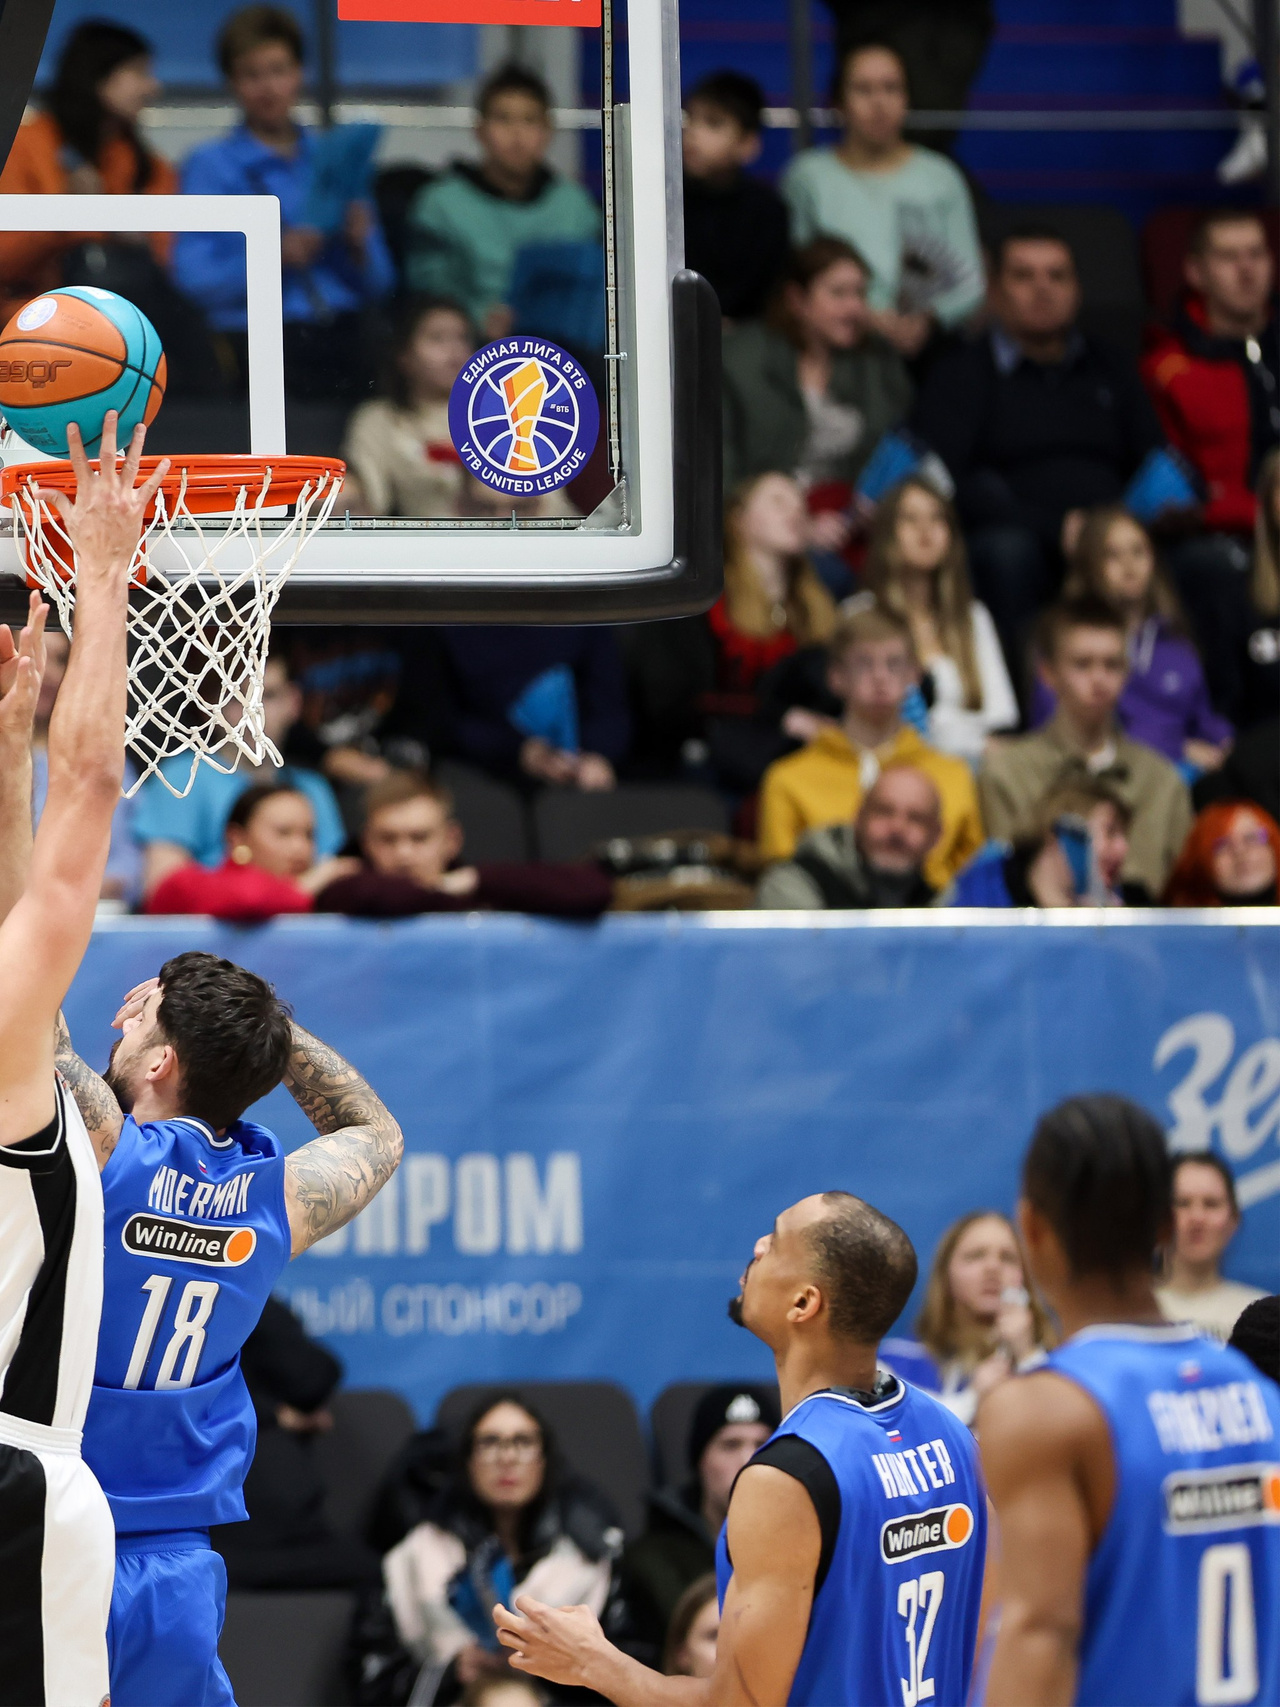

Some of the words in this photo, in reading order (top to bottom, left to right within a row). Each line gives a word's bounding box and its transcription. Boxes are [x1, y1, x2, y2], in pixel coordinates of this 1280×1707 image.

[462, 341, 519, 385] ЕДИНАЯ
[522, 341, 561, 366] ЛИГА
[561, 362, 587, 390] ВТБ
[460, 441, 483, 471] VTB
[481, 468, 534, 493] UNITED
[536, 448, 587, 491] LEAGUE
[147, 1164, 256, 1220] MOERMAN
[312, 1152, 584, 1256] ПРОМ
[135, 1222, 222, 1257] Winline
[122, 1274, 220, 1391] 18
[380, 1281, 584, 1337] СПОНСОР
[871, 1438, 956, 1500] HUNTER
[887, 1523, 941, 1553] Wnline
[897, 1570, 946, 1707] 32
[1196, 1541, 1260, 1707] 0
